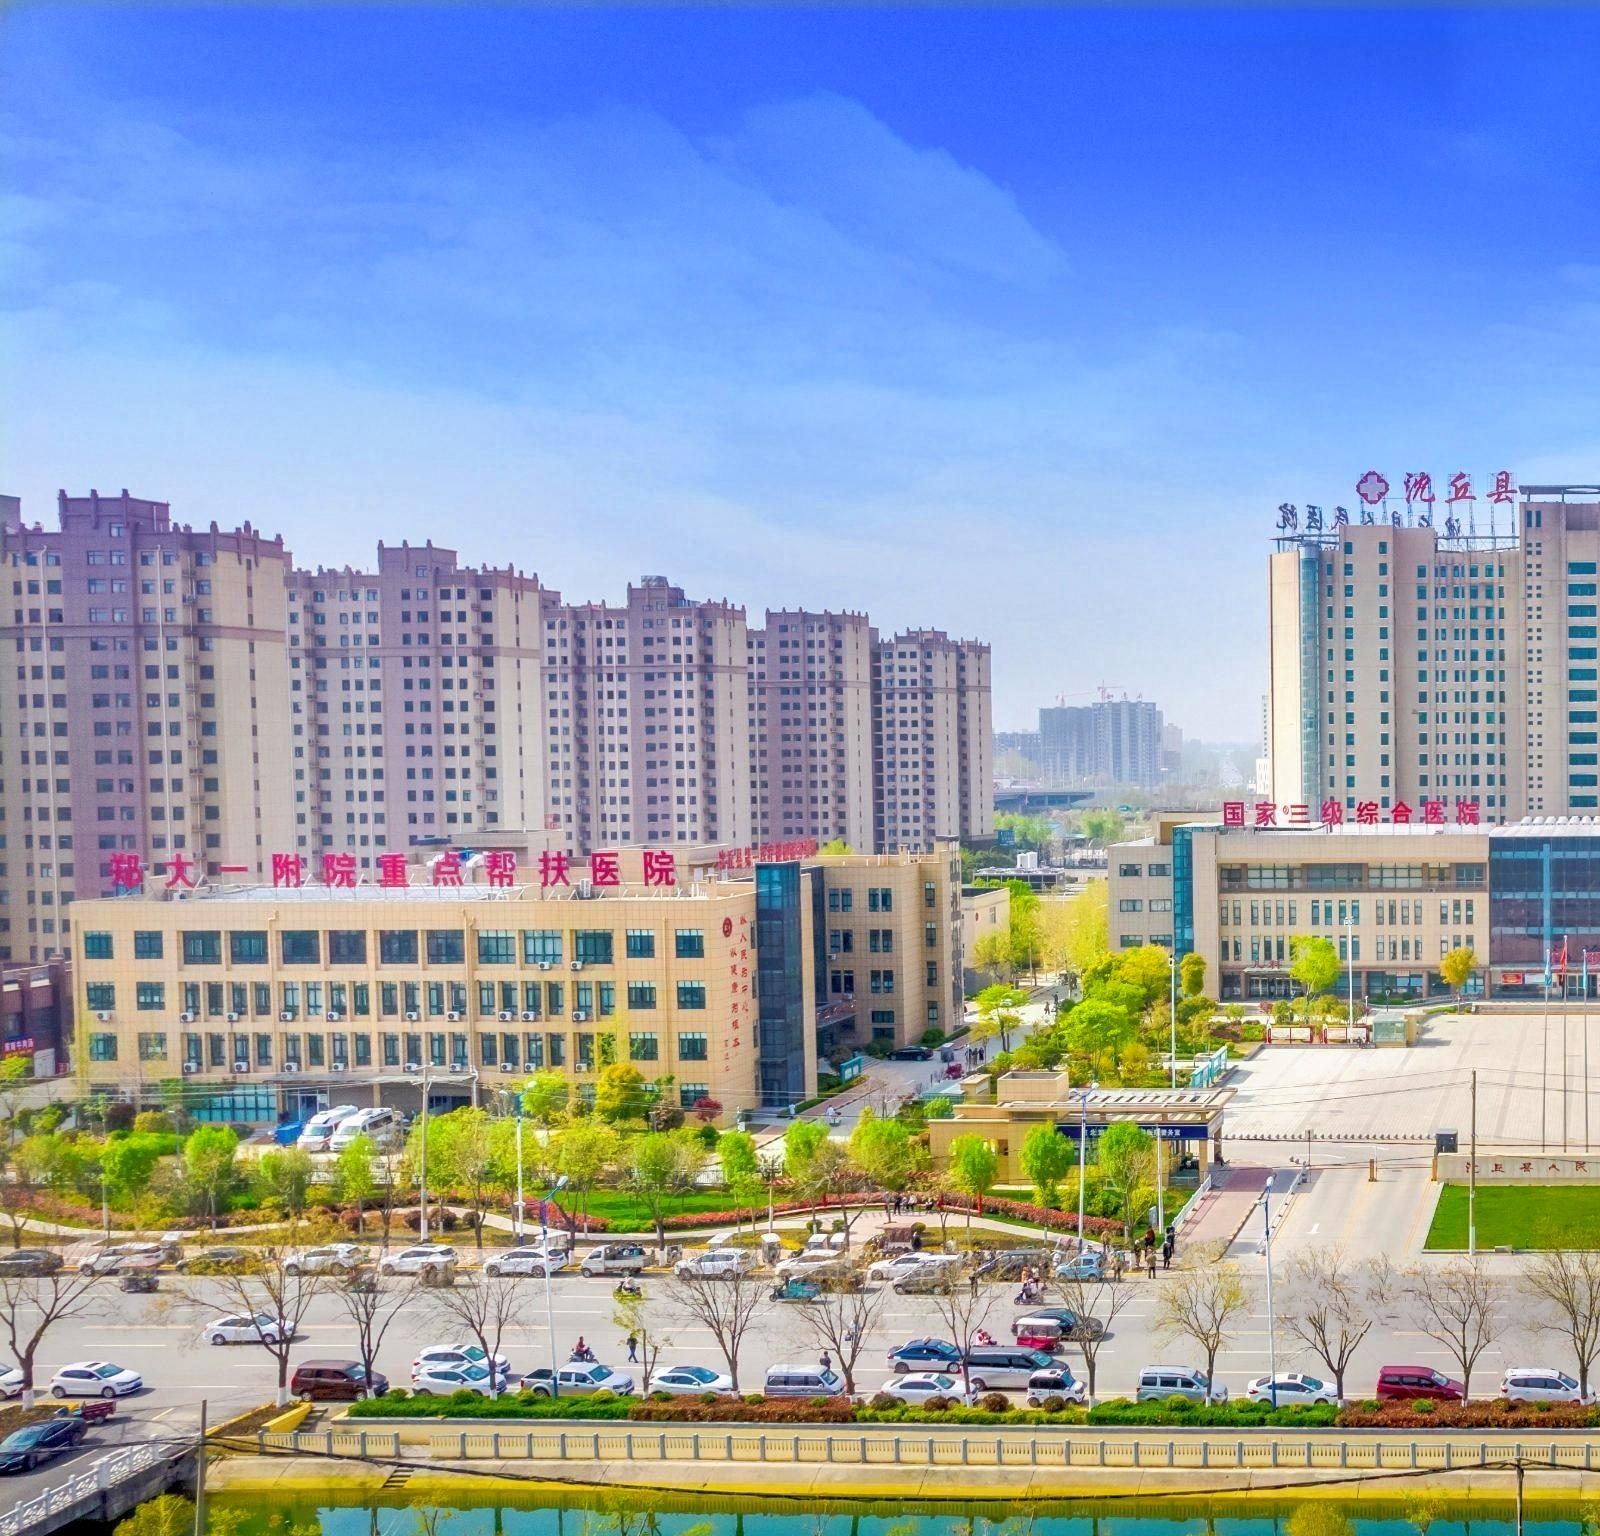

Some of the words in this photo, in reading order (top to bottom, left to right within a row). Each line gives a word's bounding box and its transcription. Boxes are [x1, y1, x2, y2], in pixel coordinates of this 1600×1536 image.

[1223, 801, 1480, 826] 国家三级综合医院
[109, 851, 676, 888] 郑大一附院重点帮扶医院
